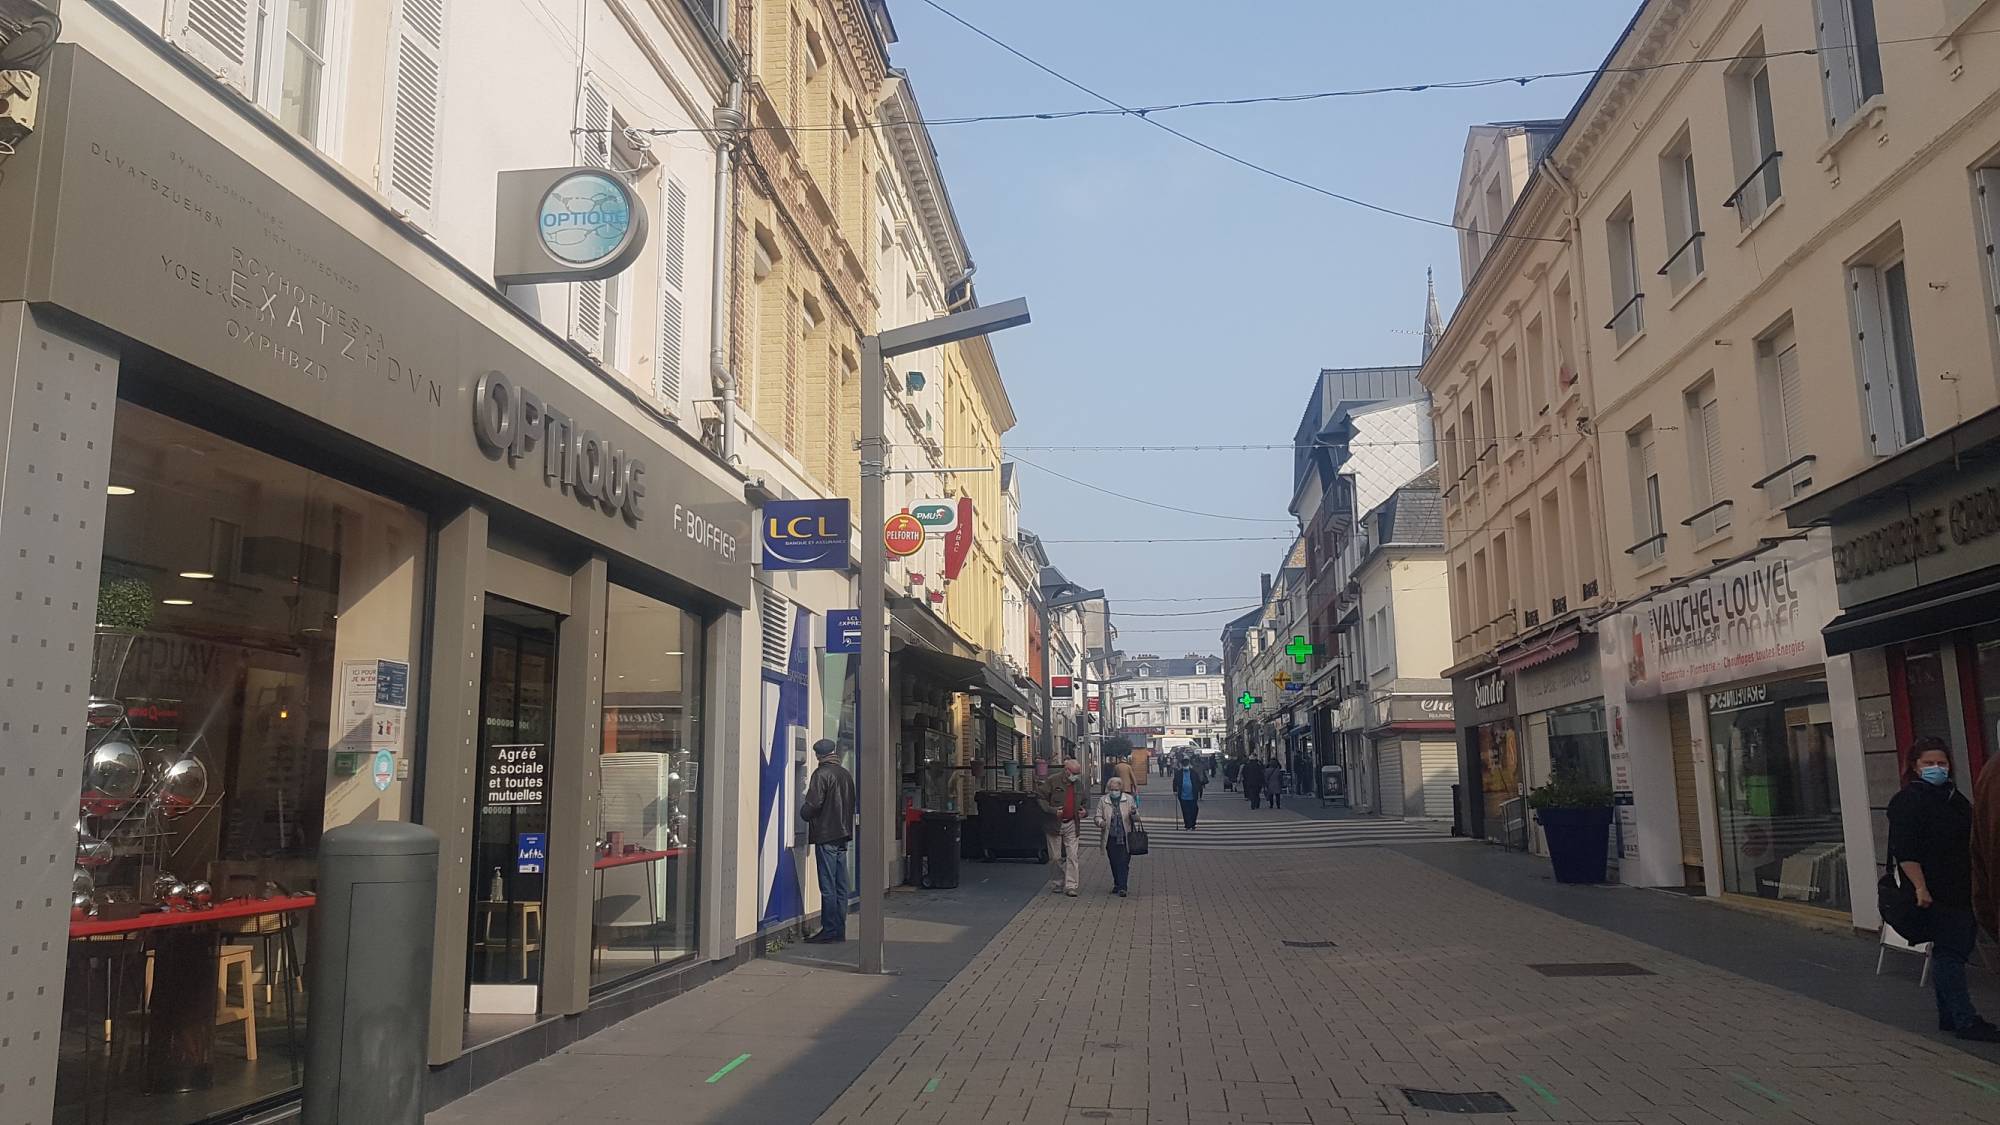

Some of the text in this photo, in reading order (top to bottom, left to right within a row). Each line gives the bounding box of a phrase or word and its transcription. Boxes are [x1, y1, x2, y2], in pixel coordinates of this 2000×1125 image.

[543, 210, 627, 227] OPTIQUE
[226, 319, 328, 382] OXPHBZD
[475, 370, 645, 522] OPTIQUE
[917, 512, 935, 520] PMU
[686, 510, 736, 562] BOIFFIER
[769, 516, 838, 539] LCL
[887, 530, 920, 541] PELFORTH
[954, 523, 964, 553] TABAC
[1652, 559, 1799, 640] VAUCHEL-LOUVEL
[498, 749, 536, 763] Agréé
[490, 761, 543, 775] s.sociale
[489, 776, 543, 788] et toutes
[488, 789, 542, 801] mutuelles
